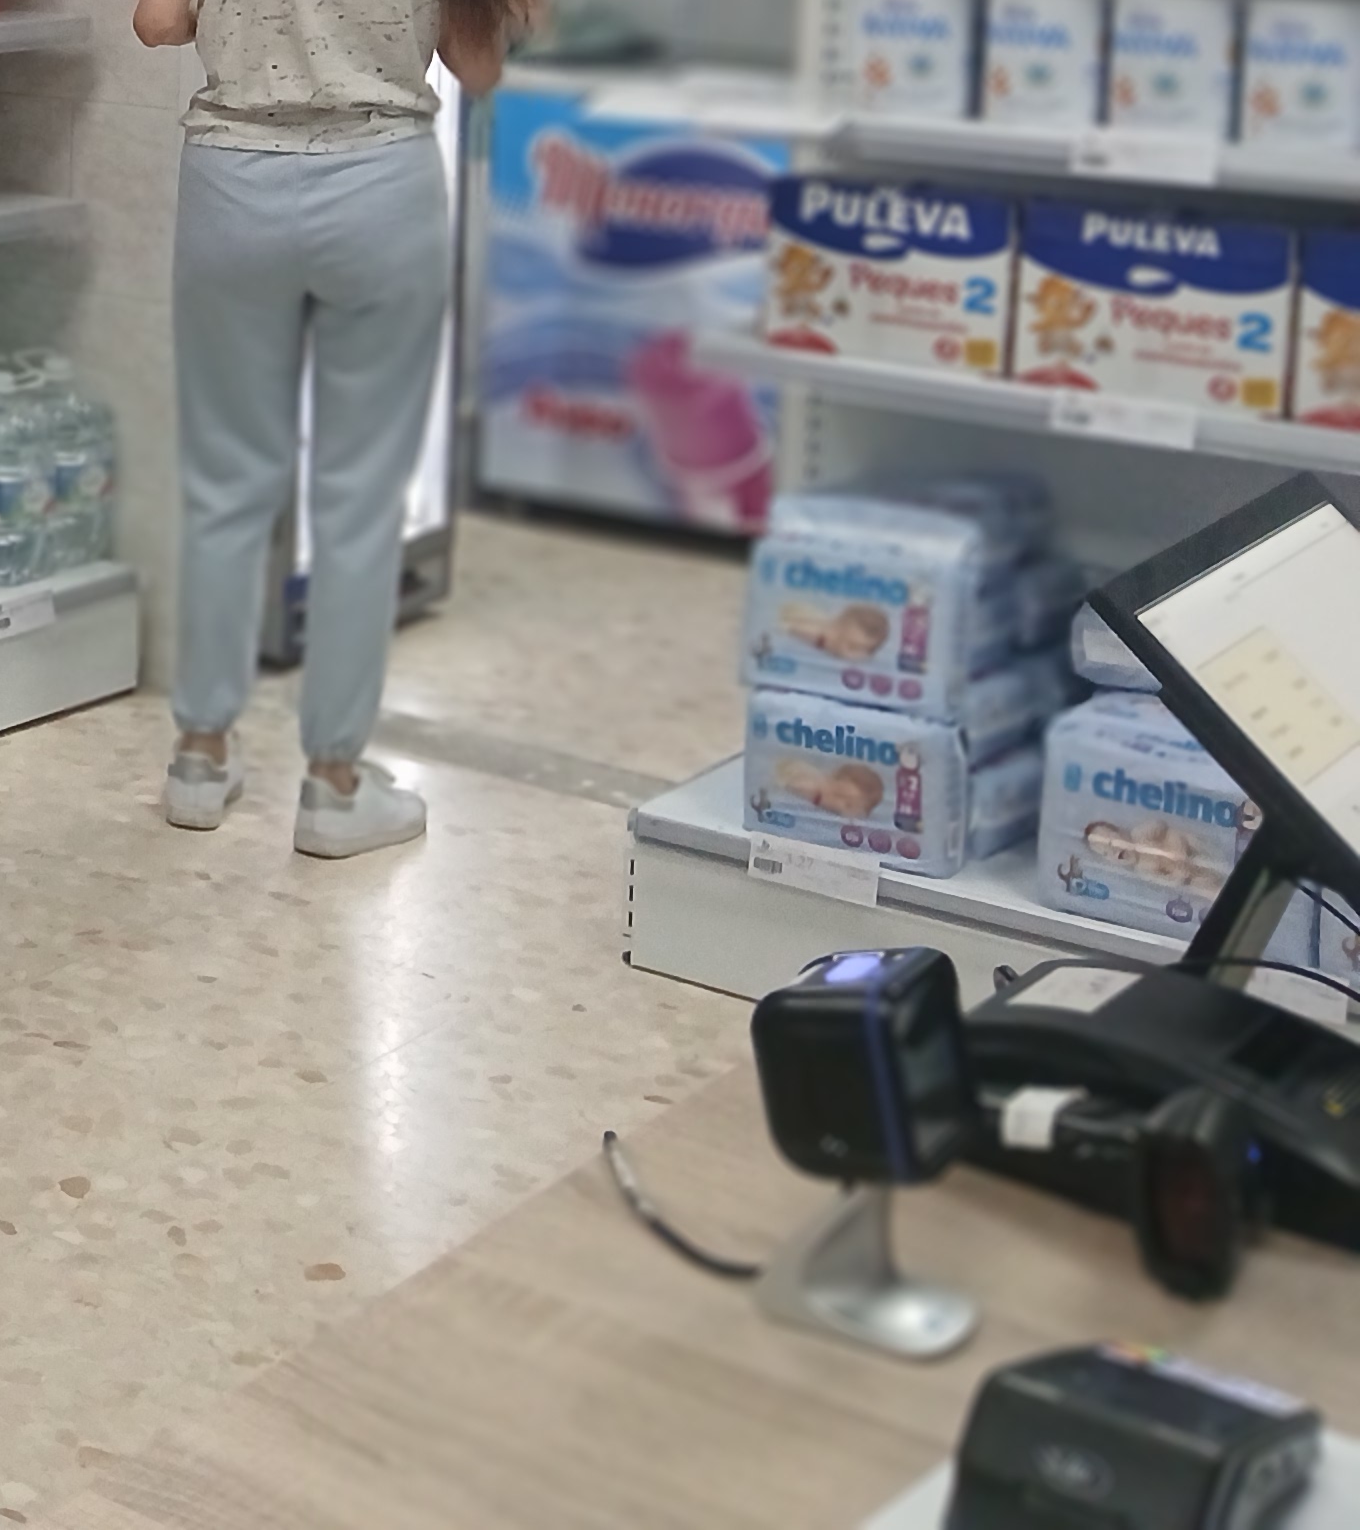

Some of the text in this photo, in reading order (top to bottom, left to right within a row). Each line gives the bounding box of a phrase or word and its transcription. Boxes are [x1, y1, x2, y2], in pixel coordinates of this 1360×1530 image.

[799, 184, 975, 245] PULEVA
[1083, 213, 1222, 260] PULEVA
[849, 263, 959, 308] Peques
[962, 277, 998, 316] 2
[1109, 296, 1232, 343] Peques
[1237, 311, 1274, 354] 2
[784, 555, 910, 605] chelino
[775, 715, 899, 765] chelino
[1091, 768, 1239, 827] chelino
